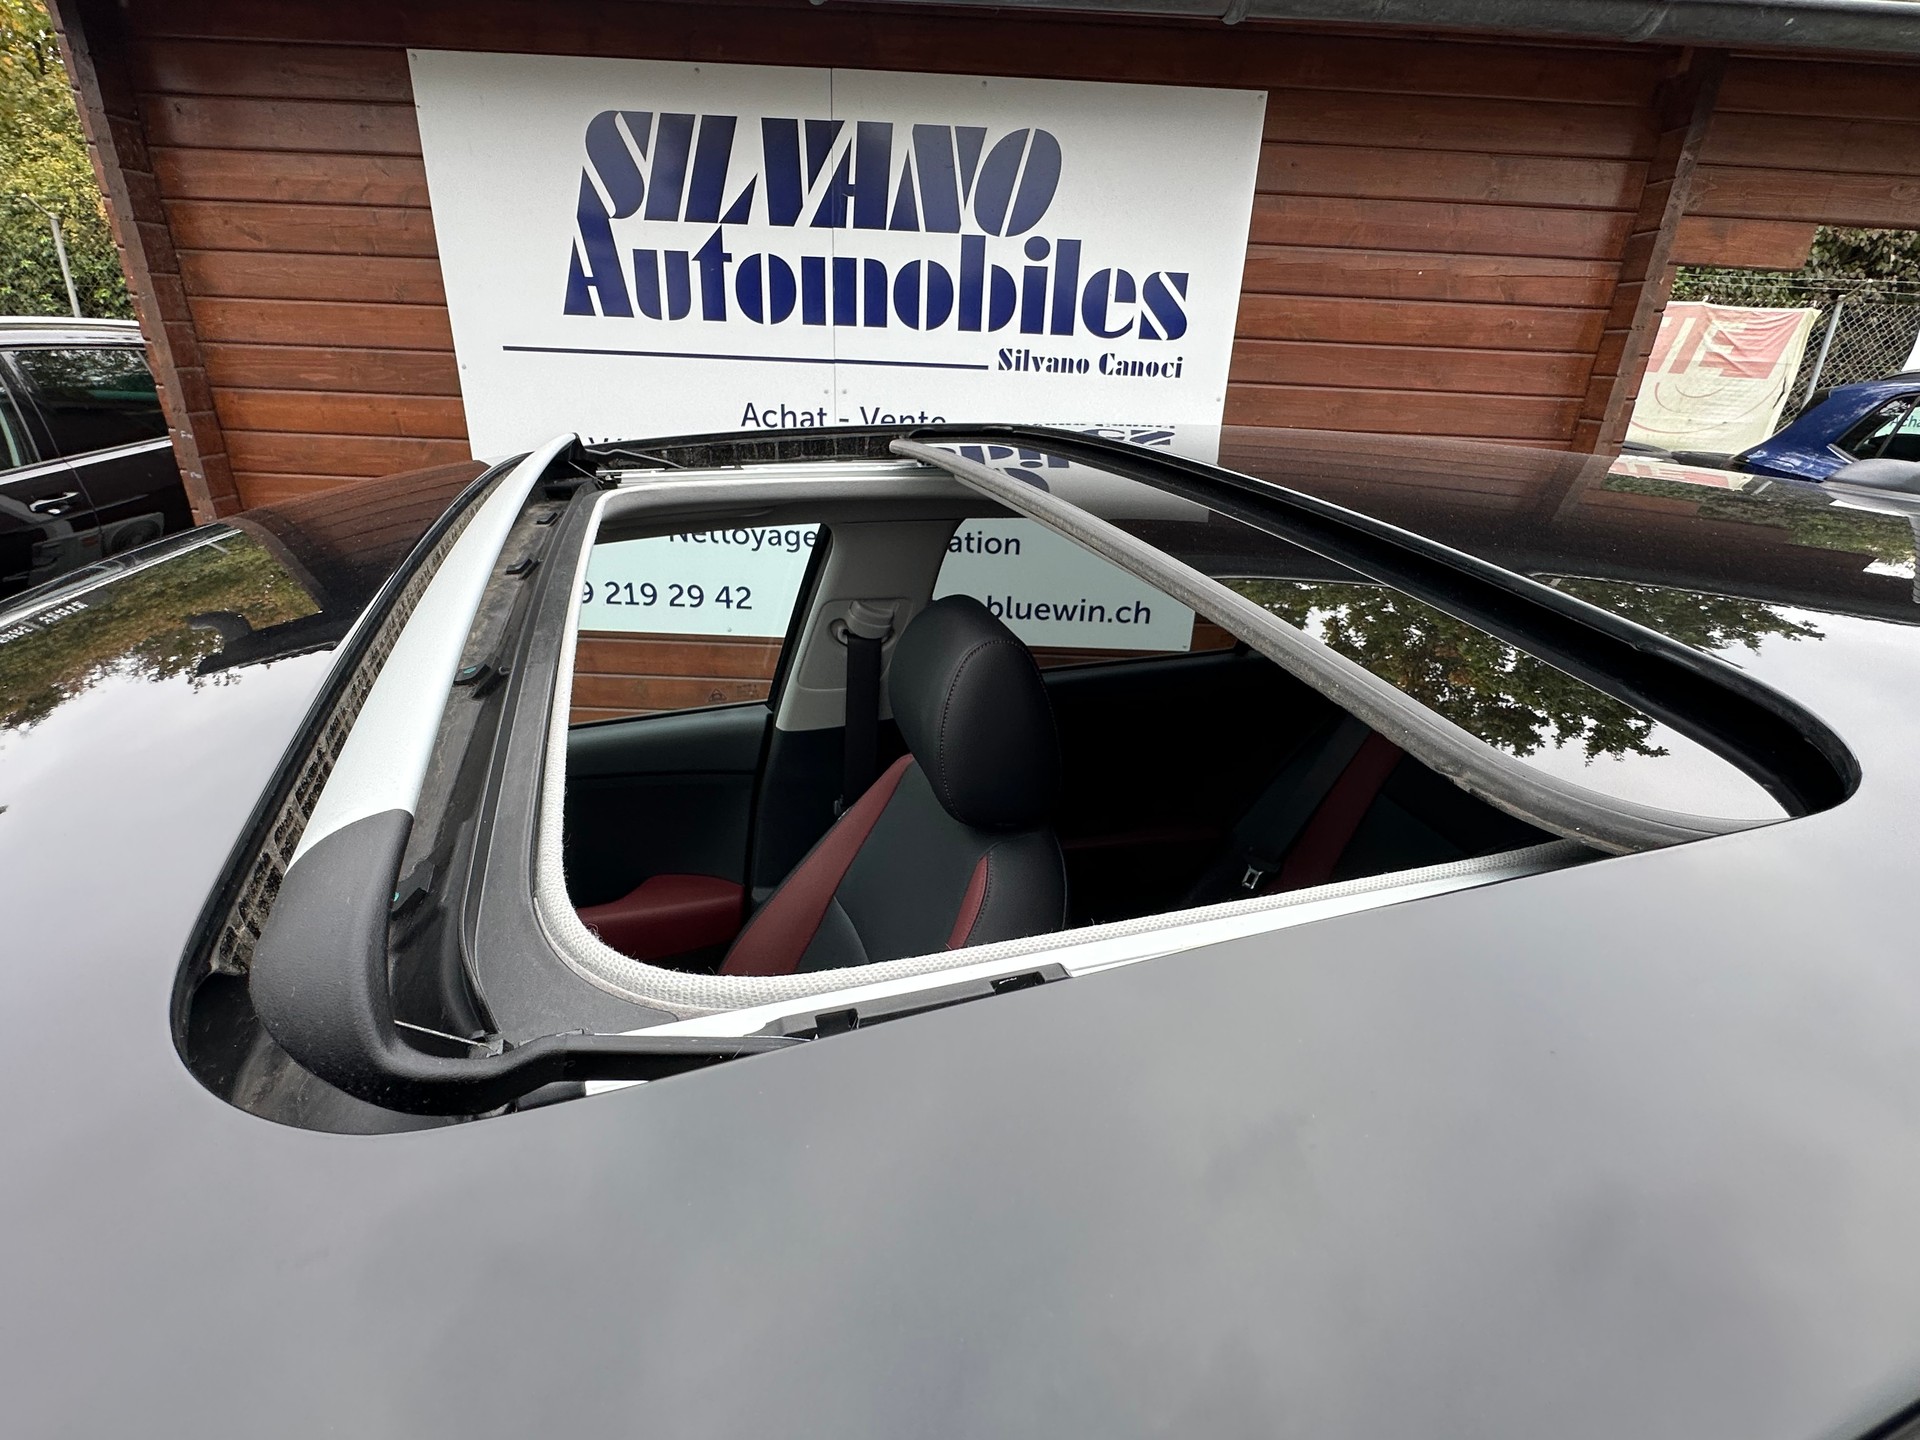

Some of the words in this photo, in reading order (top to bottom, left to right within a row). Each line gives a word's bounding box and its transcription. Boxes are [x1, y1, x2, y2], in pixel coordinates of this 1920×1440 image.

[576, 110, 1062, 238] SILVANO
[563, 218, 1190, 341] Automobiles
[998, 348, 1090, 375] Silvano
[1099, 353, 1184, 379] Canoci
[741, 402, 828, 428] Achat
[604, 581, 658, 606] 219
[668, 583, 705, 608] 29
[715, 585, 753, 610] 42
